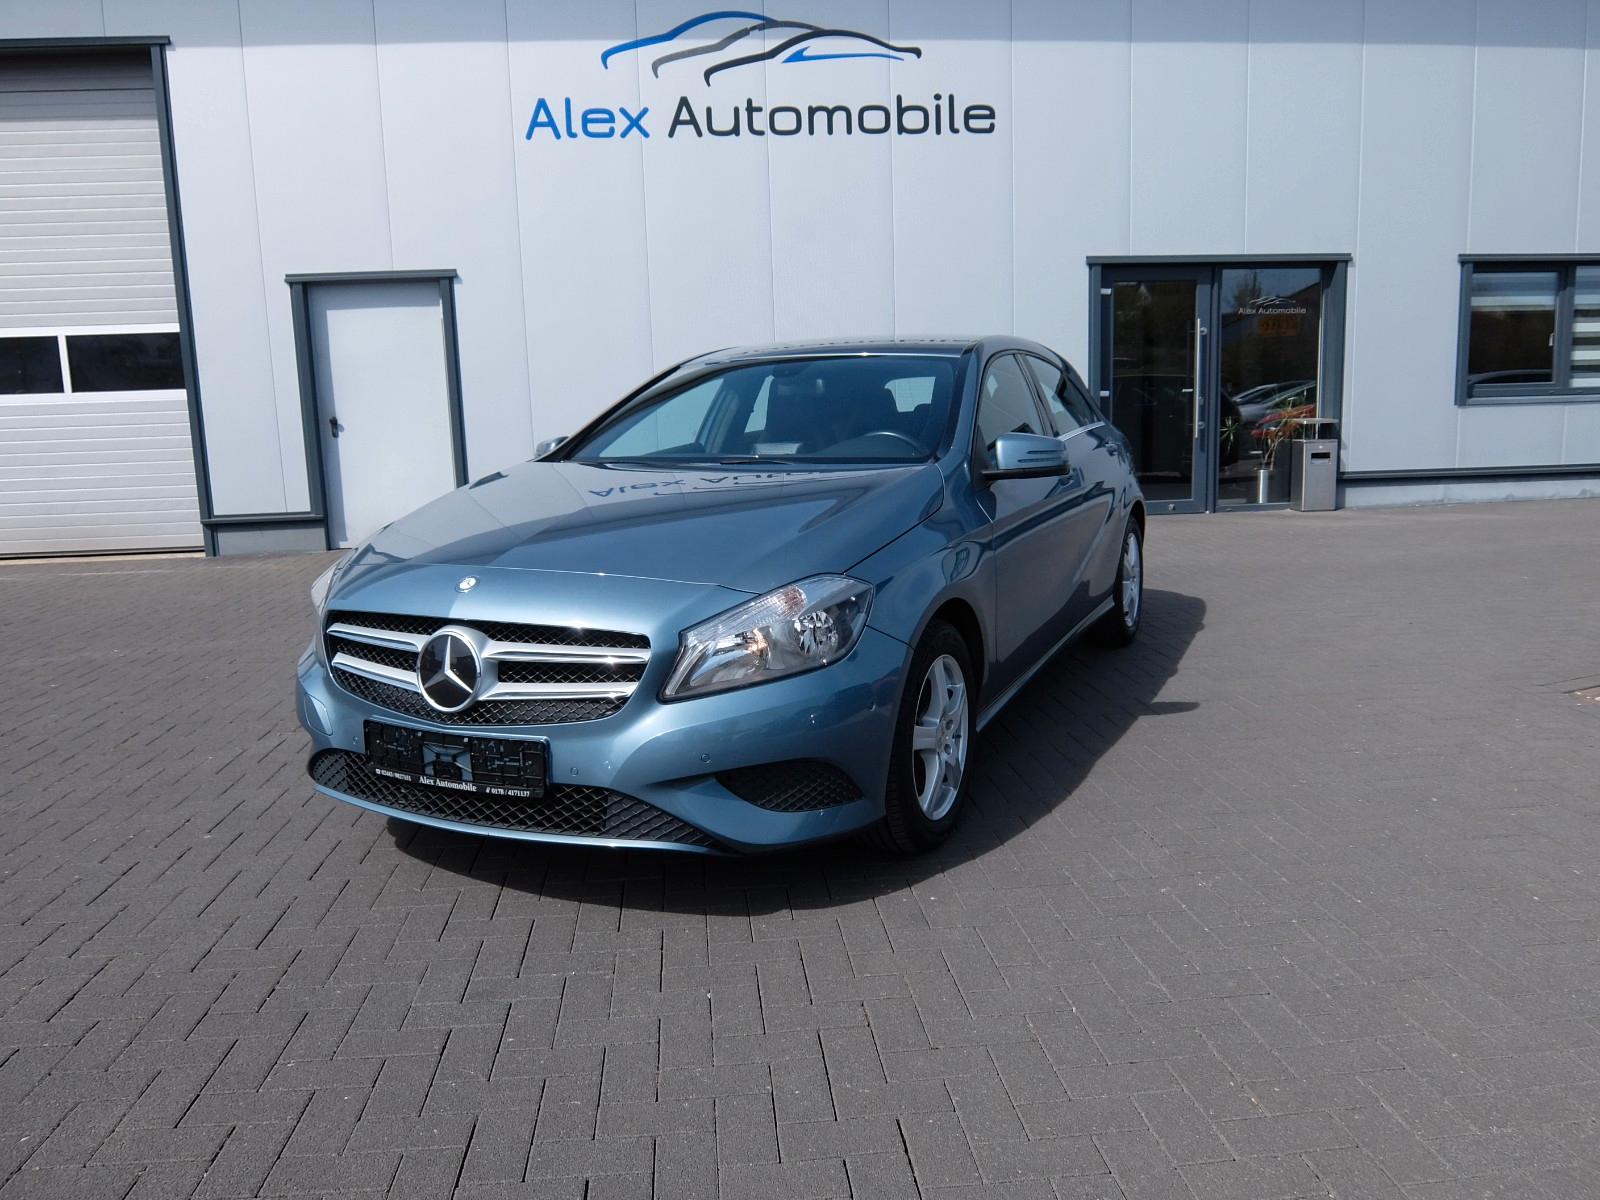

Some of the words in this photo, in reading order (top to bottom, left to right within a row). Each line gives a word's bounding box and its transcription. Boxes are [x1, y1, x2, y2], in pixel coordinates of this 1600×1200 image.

[525, 96, 650, 140] Alex
[667, 94, 996, 138] Automobile
[1238, 307, 1257, 315] Alex
[1258, 306, 1307, 314] Automobile
[419, 775, 435, 787] Alex
[435, 778, 477, 792] Automobile
